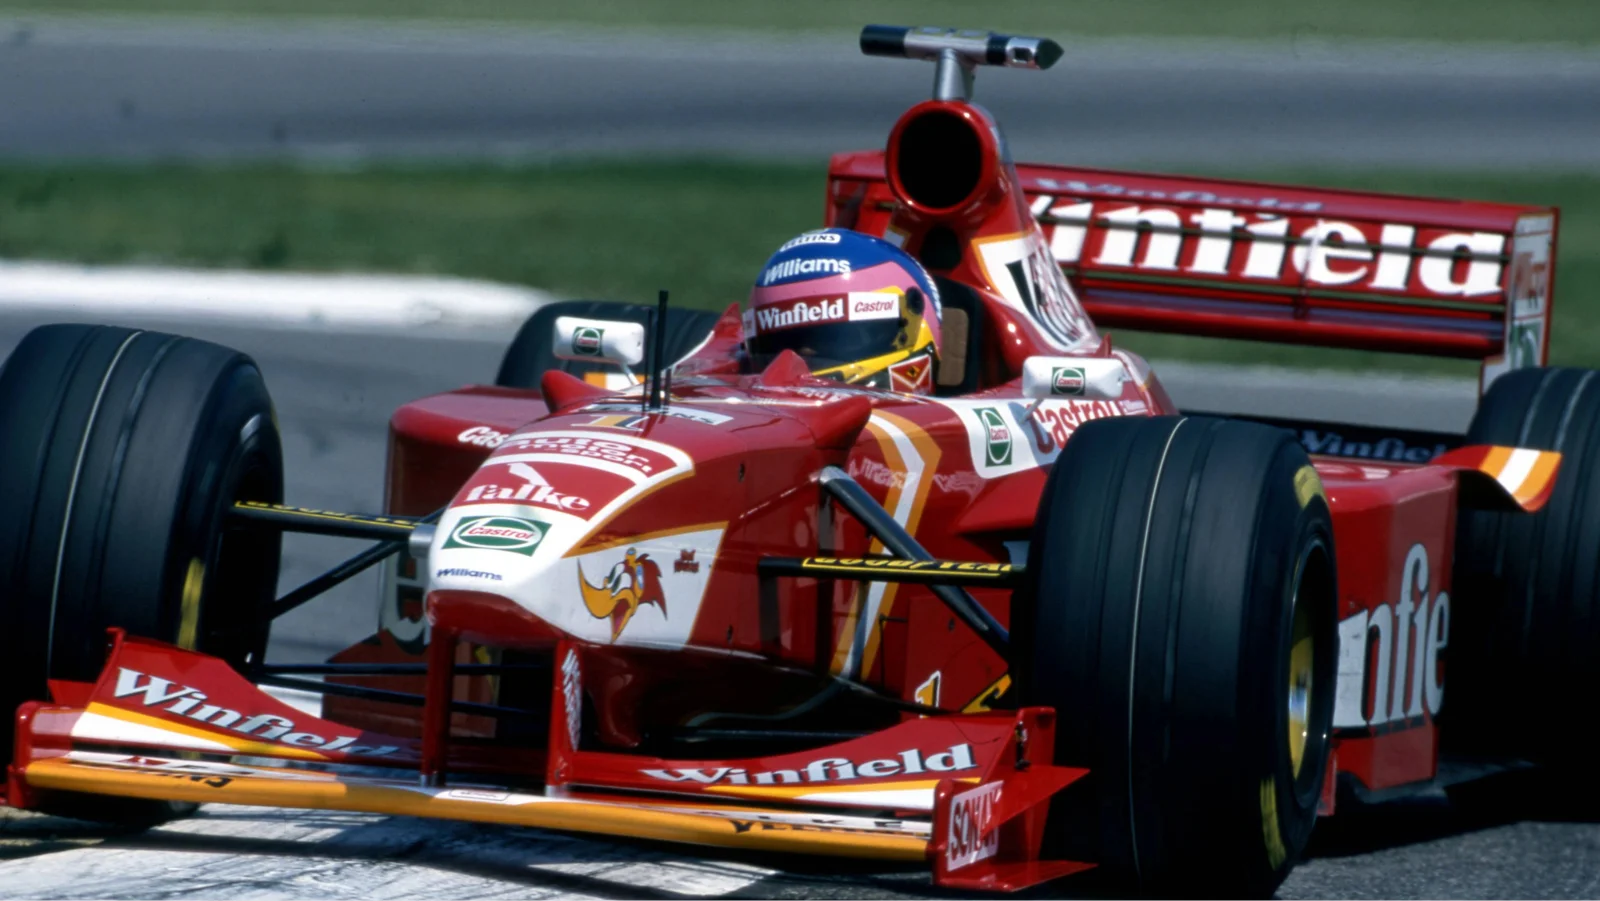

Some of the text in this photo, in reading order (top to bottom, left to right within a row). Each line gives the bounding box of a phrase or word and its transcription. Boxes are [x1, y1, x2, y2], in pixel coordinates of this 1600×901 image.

[1031, 195, 1505, 297] infield
[763, 257, 851, 286] Williams
[757, 298, 845, 331] Winfield
[854, 300, 894, 313] Castrol
[464, 483, 590, 511] falke
[467, 525, 535, 541] Castrol
[436, 568, 503, 581] Williams
[113, 667, 401, 756] Winfield
[639, 743, 979, 785] Winfield
